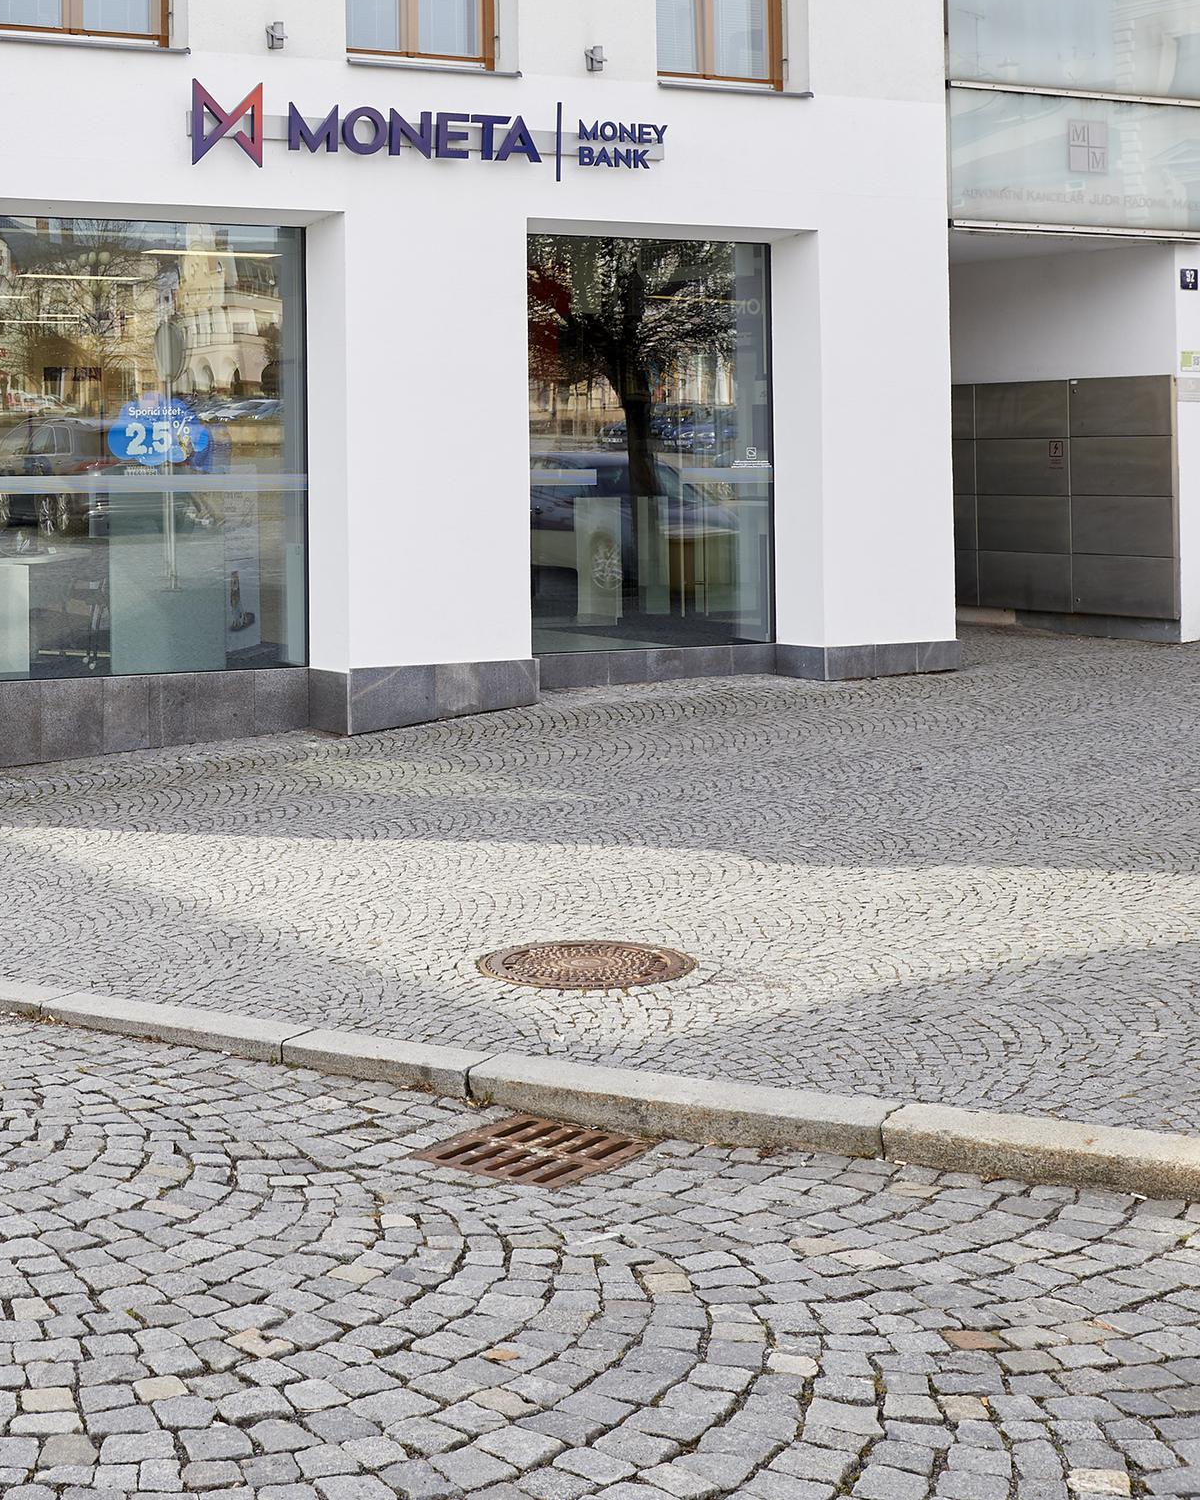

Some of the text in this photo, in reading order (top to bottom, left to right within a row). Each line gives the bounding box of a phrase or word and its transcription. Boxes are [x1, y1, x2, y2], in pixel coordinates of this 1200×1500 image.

[288, 101, 668, 163] MONETA MONEY
[578, 145, 650, 170] BANK
